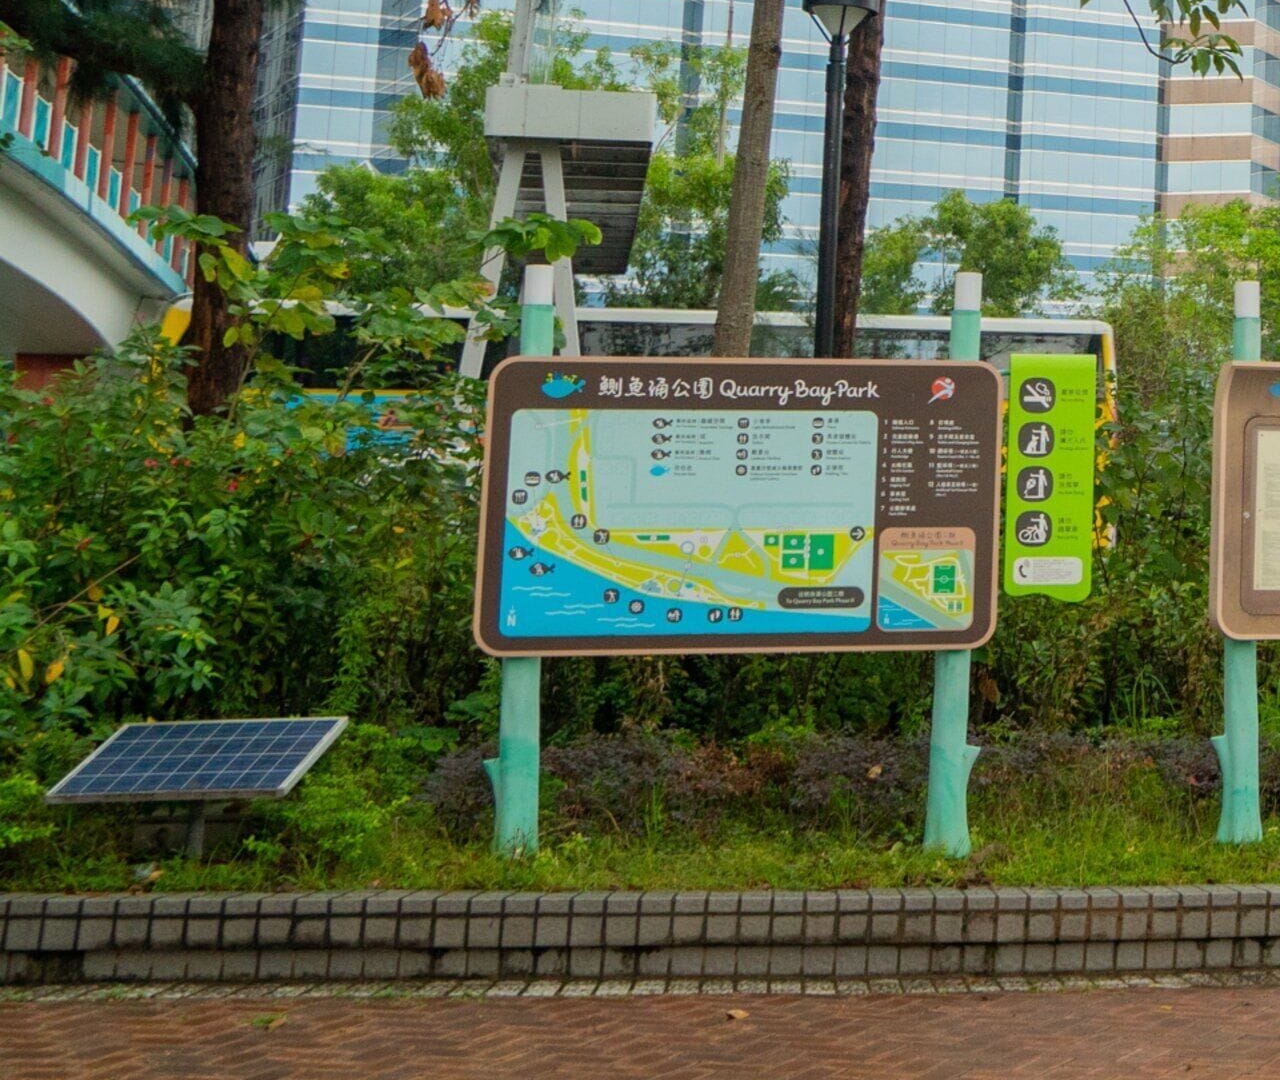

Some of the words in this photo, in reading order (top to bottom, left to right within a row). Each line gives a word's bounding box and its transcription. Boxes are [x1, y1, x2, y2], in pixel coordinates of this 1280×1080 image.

[598, 375, 714, 400] 鰂魚涌公園
[719, 379, 793, 406] Quarry
[794, 379, 836, 406] Bay
[835, 379, 880, 398] Park
